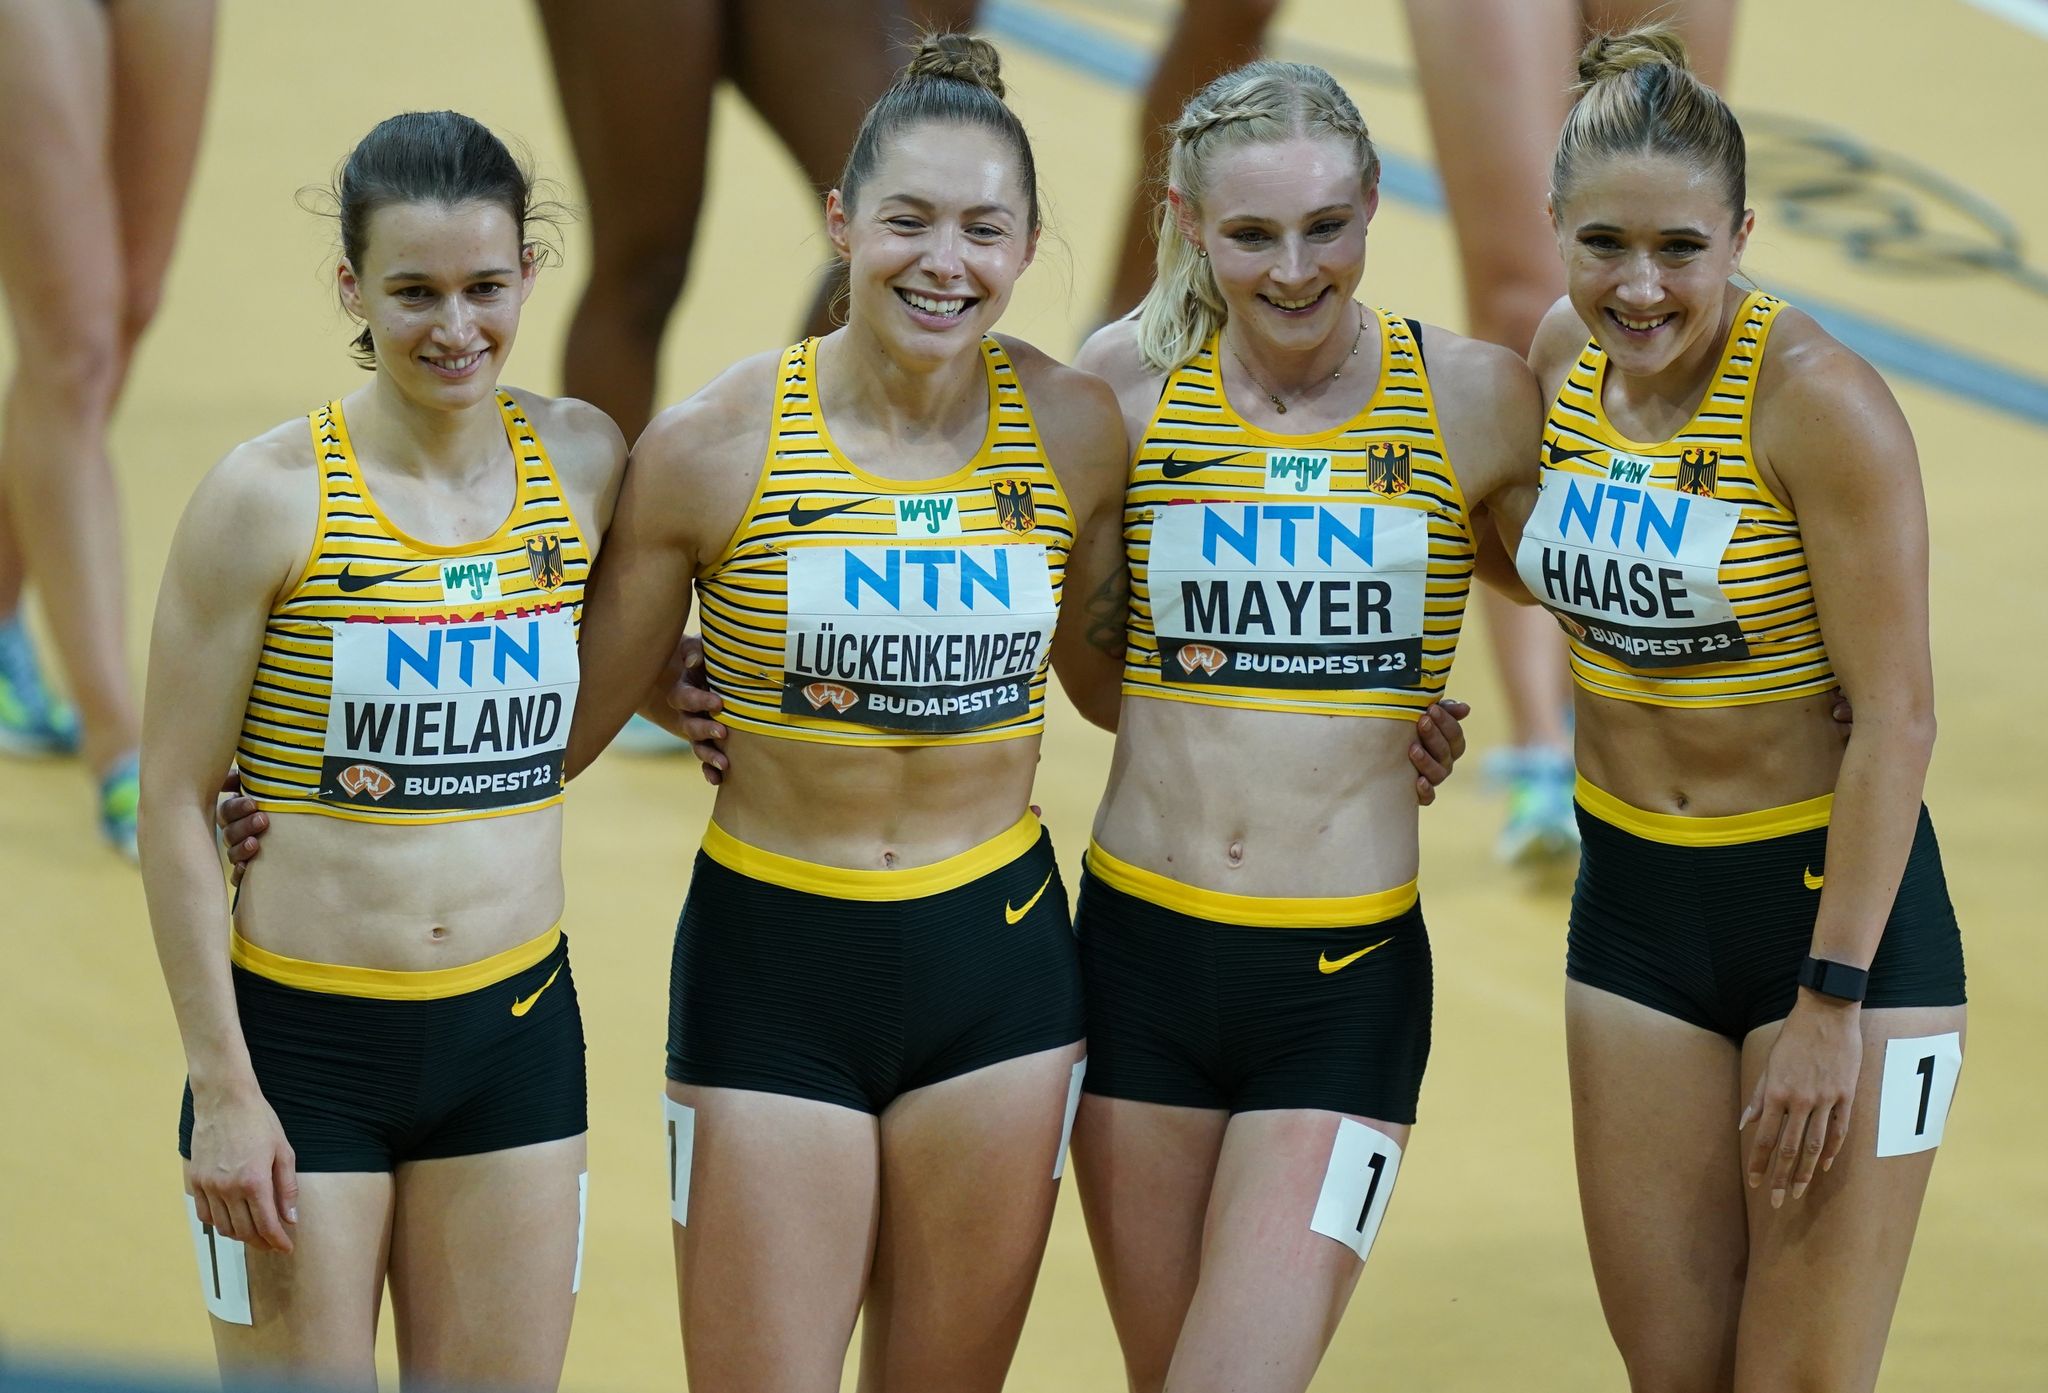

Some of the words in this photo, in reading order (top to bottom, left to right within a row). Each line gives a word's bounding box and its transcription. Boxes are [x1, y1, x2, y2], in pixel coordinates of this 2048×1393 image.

[1202, 505, 1375, 568] NTN
[1558, 477, 1691, 559] NTN
[844, 548, 1011, 611] NTN
[1181, 580, 1393, 636] MAYER
[1541, 546, 1695, 619] HAASE
[385, 621, 540, 690] NTN
[795, 622, 1042, 683] LÜCKENKEMPER
[1235, 652, 1377, 675] BUDAPEST
[1378, 652, 1407, 672] 23
[1590, 626, 1696, 657] BUDAPEST
[1697, 634, 1733, 652] 23
[344, 692, 562, 757] WIELAND
[868, 689, 994, 717] BUDAPEST
[995, 683, 1020, 707] 23
[404, 769, 533, 796] BUDAPEST
[532, 765, 552, 789] 23
[1915, 1055, 1936, 1136] 1
[1356, 1152, 1387, 1234] 1
